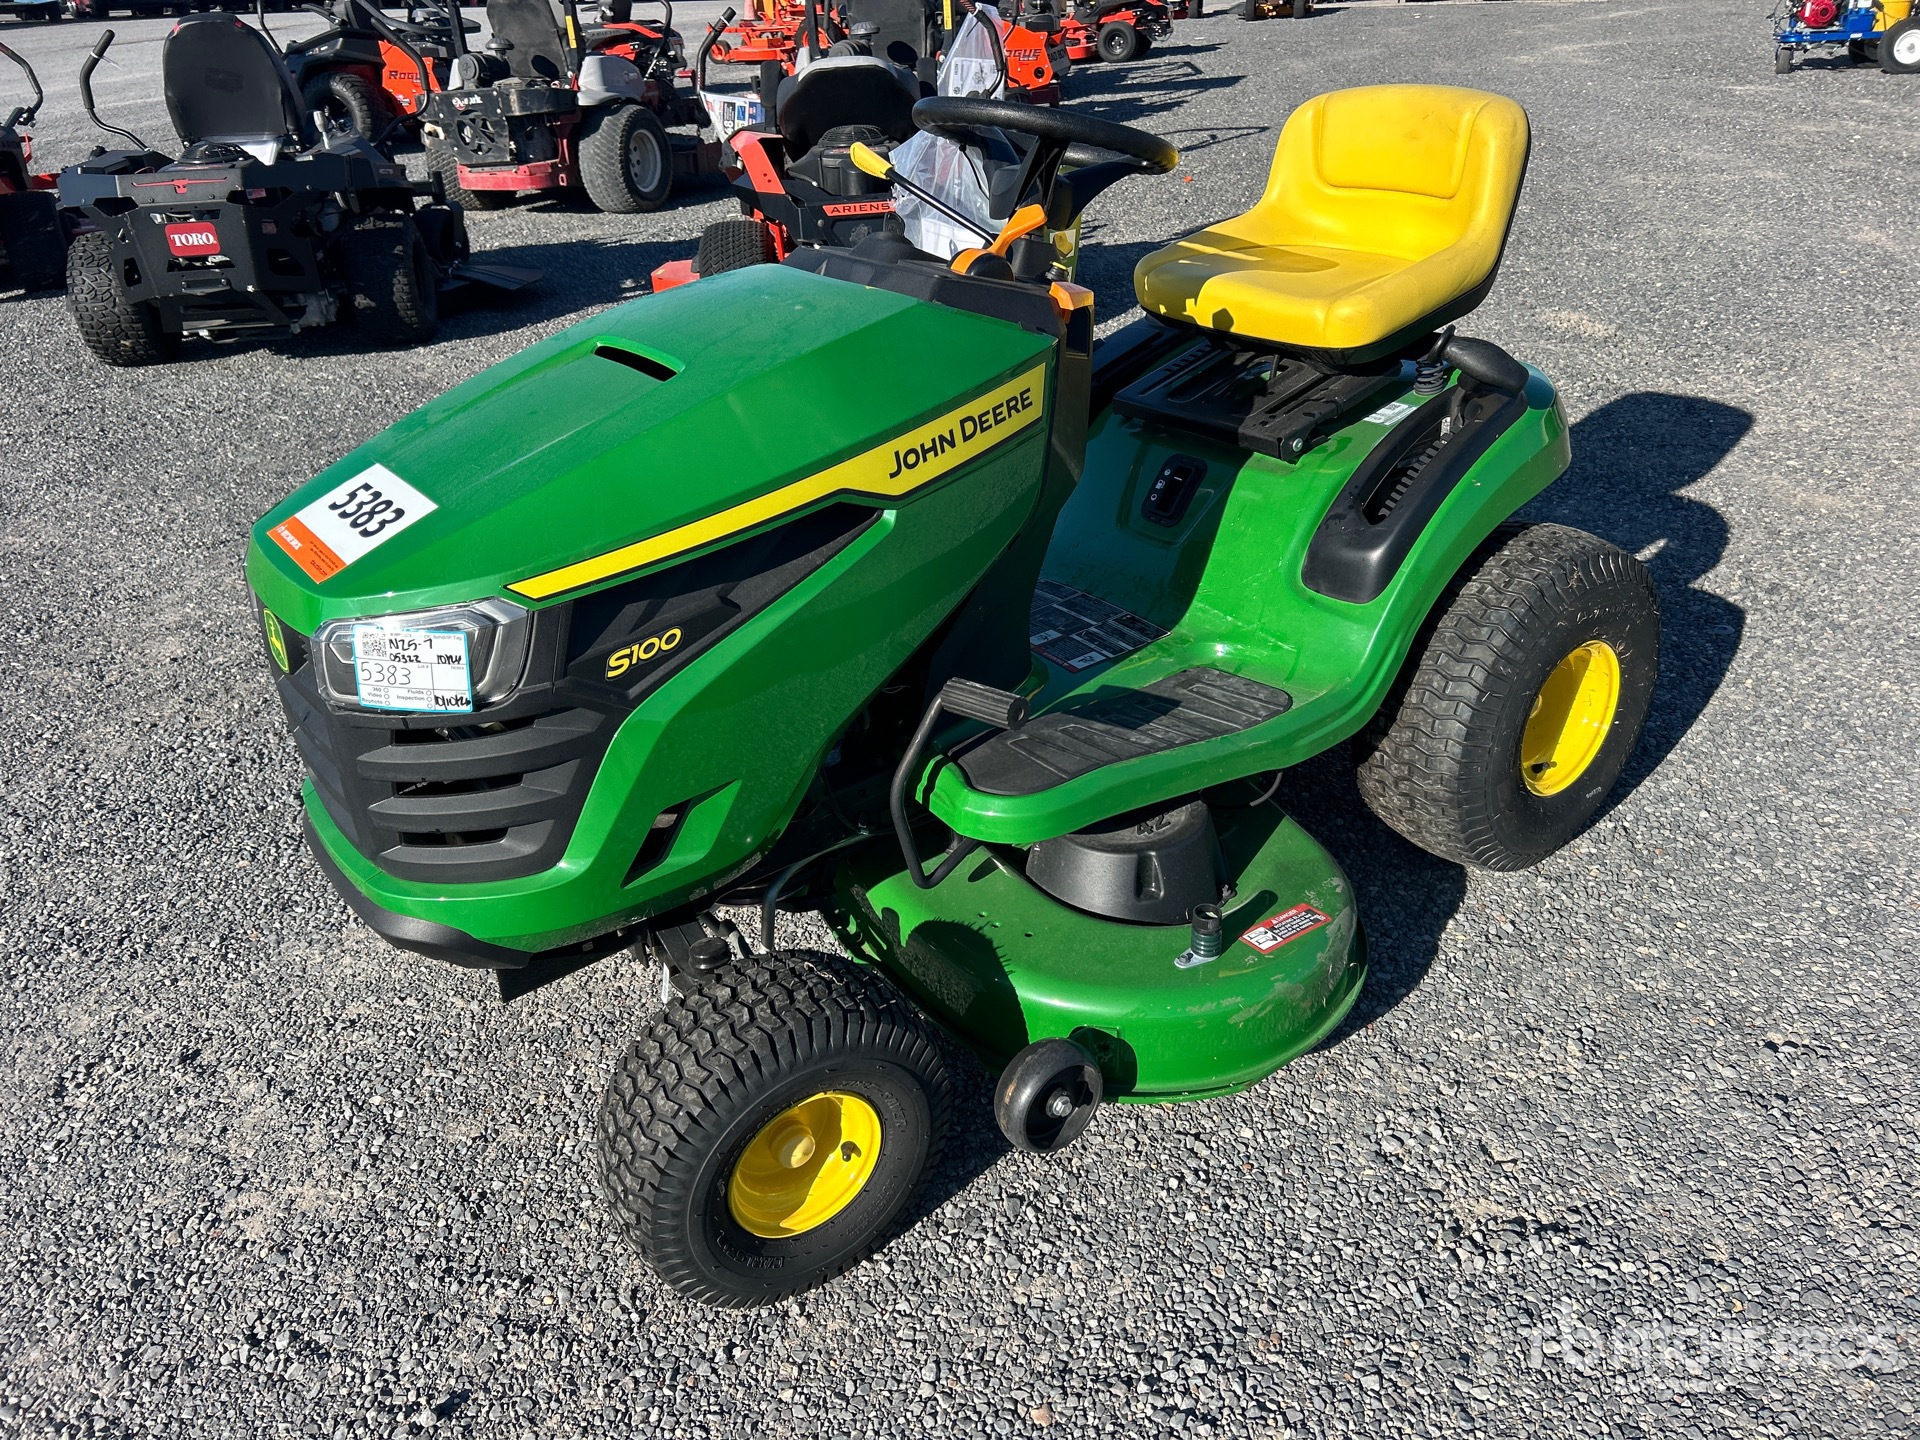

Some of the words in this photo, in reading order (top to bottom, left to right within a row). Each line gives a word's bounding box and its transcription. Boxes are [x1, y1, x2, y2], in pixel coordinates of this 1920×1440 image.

[831, 203, 890, 214] ARIENS
[170, 231, 215, 247] TORO
[889, 428, 956, 479] JOHN
[960, 387, 1033, 443] DEERE
[328, 482, 405, 538] 5383
[607, 628, 682, 677] S100
[361, 661, 411, 686] 5383
